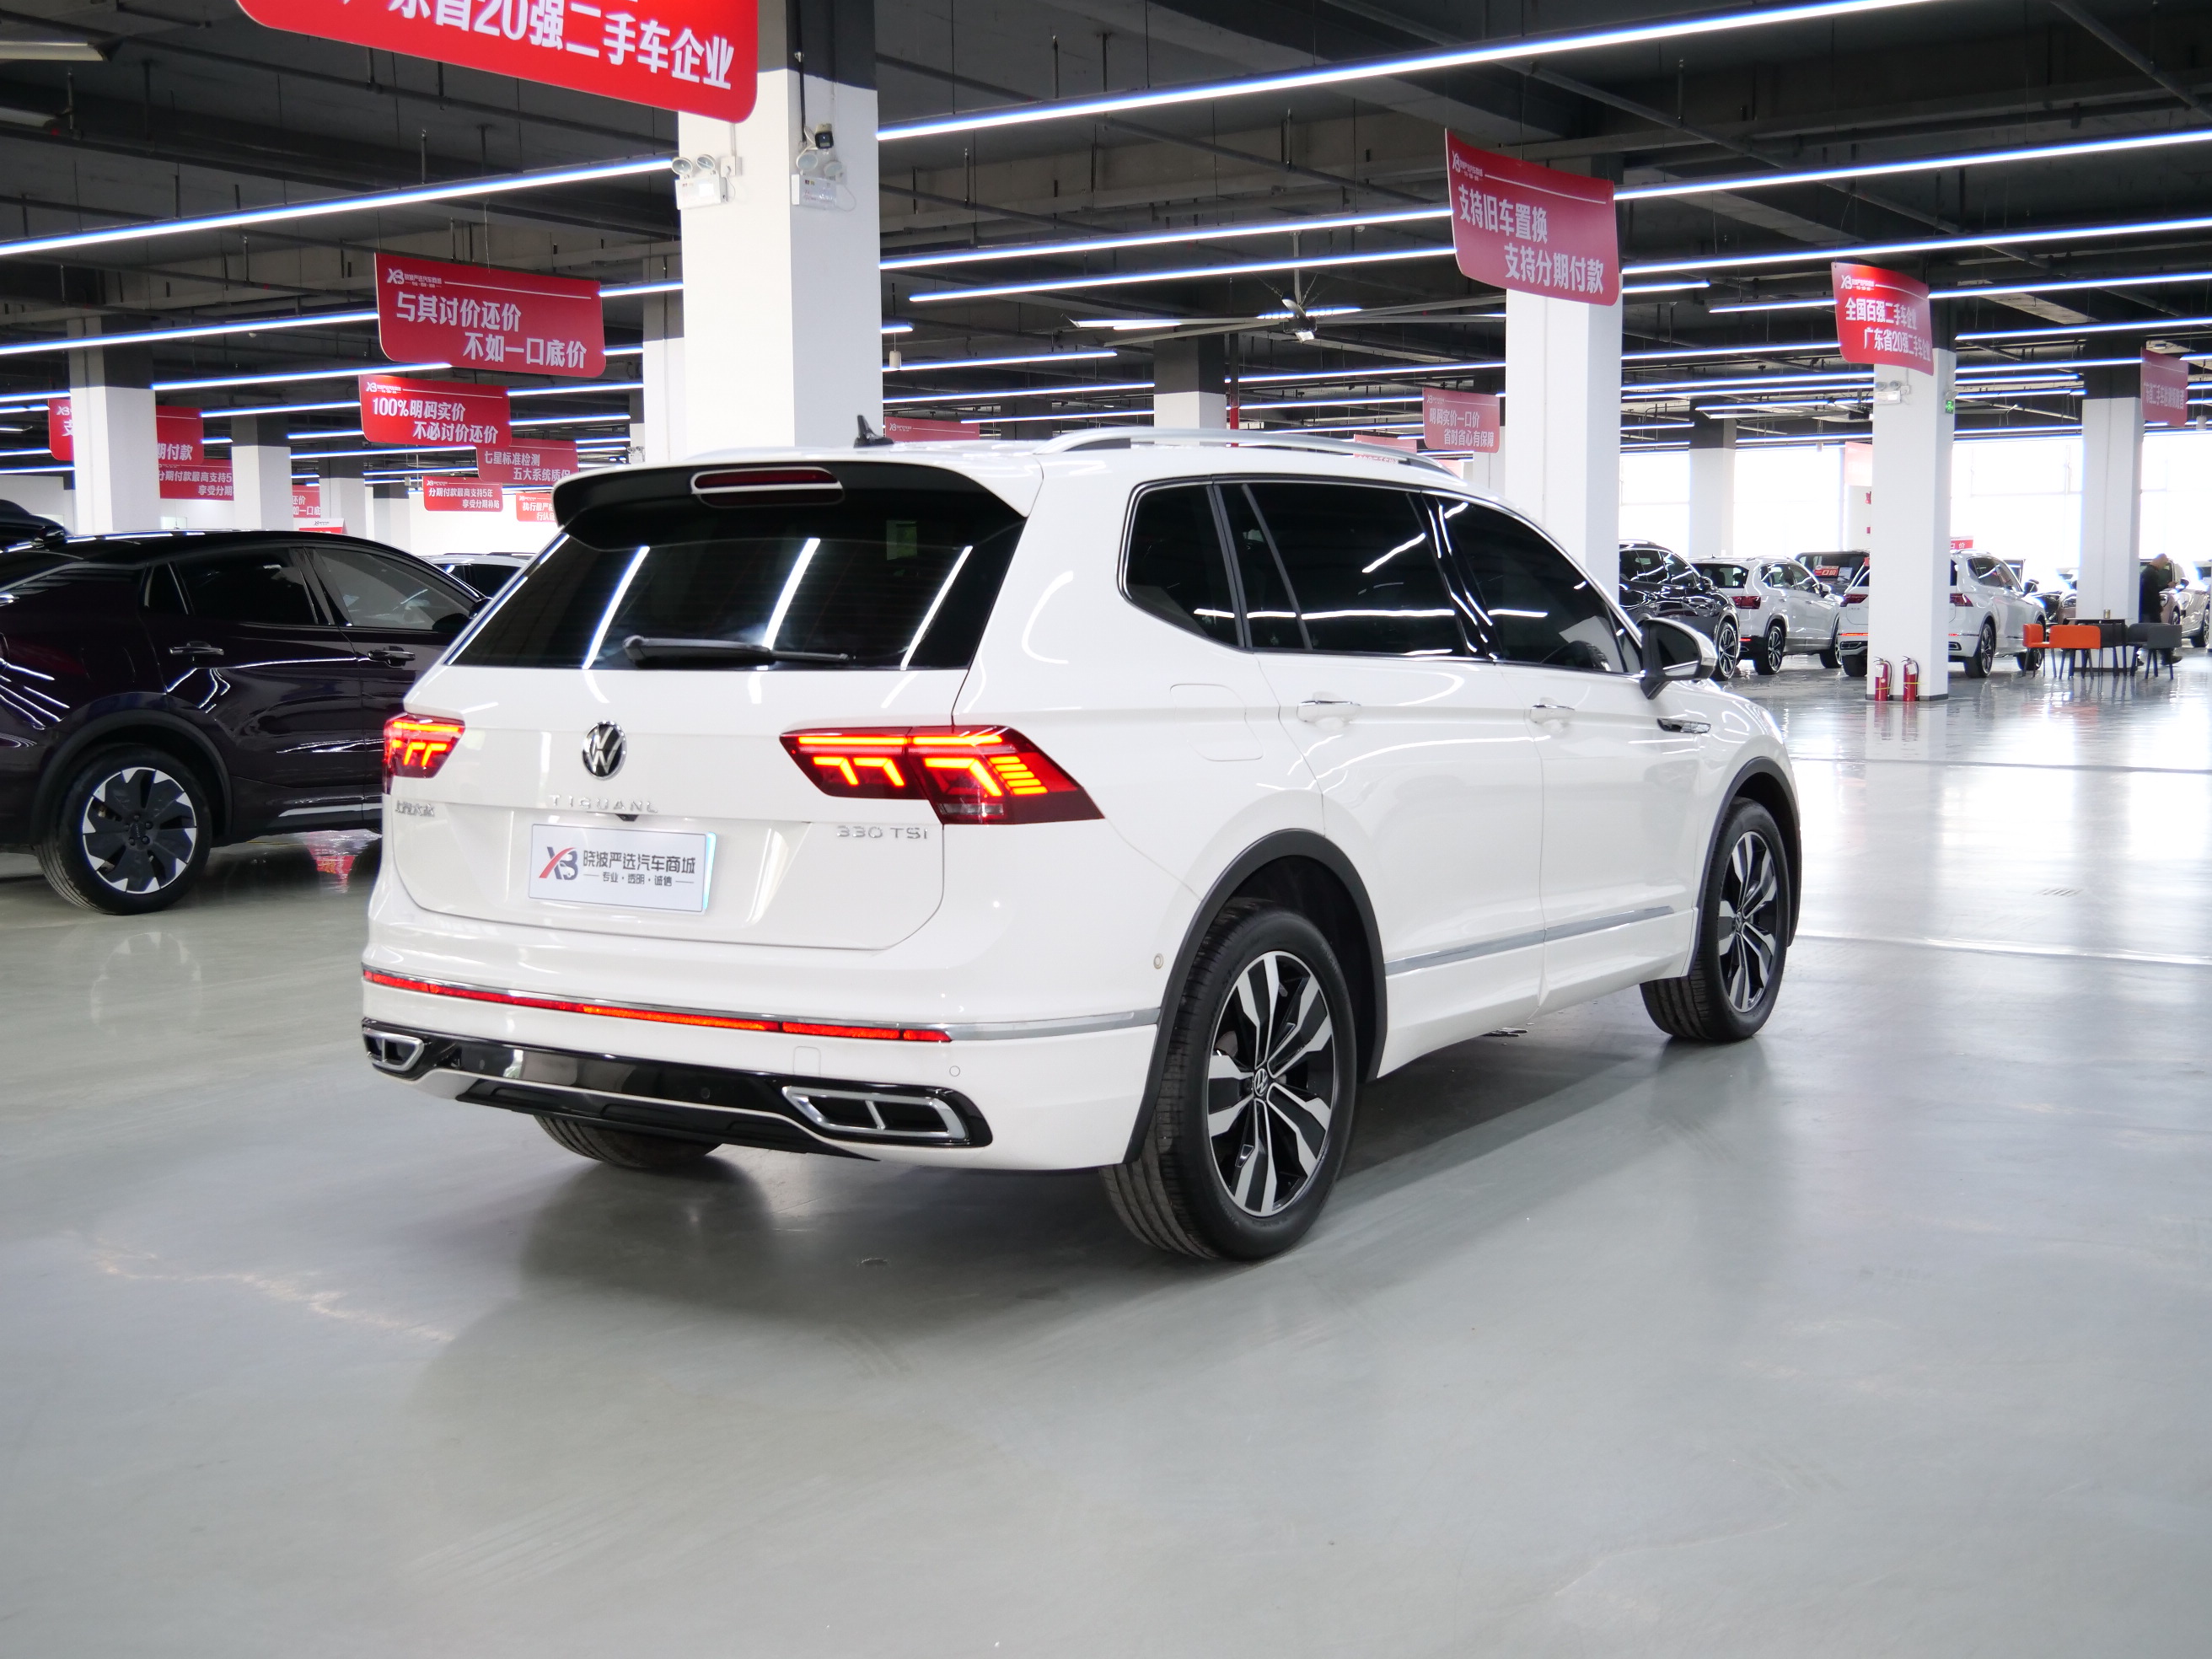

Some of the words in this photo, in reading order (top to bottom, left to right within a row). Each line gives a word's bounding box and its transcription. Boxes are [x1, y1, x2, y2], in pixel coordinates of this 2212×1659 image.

[1458, 184, 1548, 244] 支持旧车置换
[1504, 242, 1605, 295] 支持分期付款
[396, 291, 522, 332] 与其讨价还价
[463, 331, 587, 369] 不如一口底价
[372, 397, 465, 421] 100%明码实价
[413, 421, 499, 444] 不必讨价还价
[485, 450, 540, 467] 七星标准检测
[836, 824, 883, 838] 330
[583, 850, 696, 874] 晓波严选汽车商城
